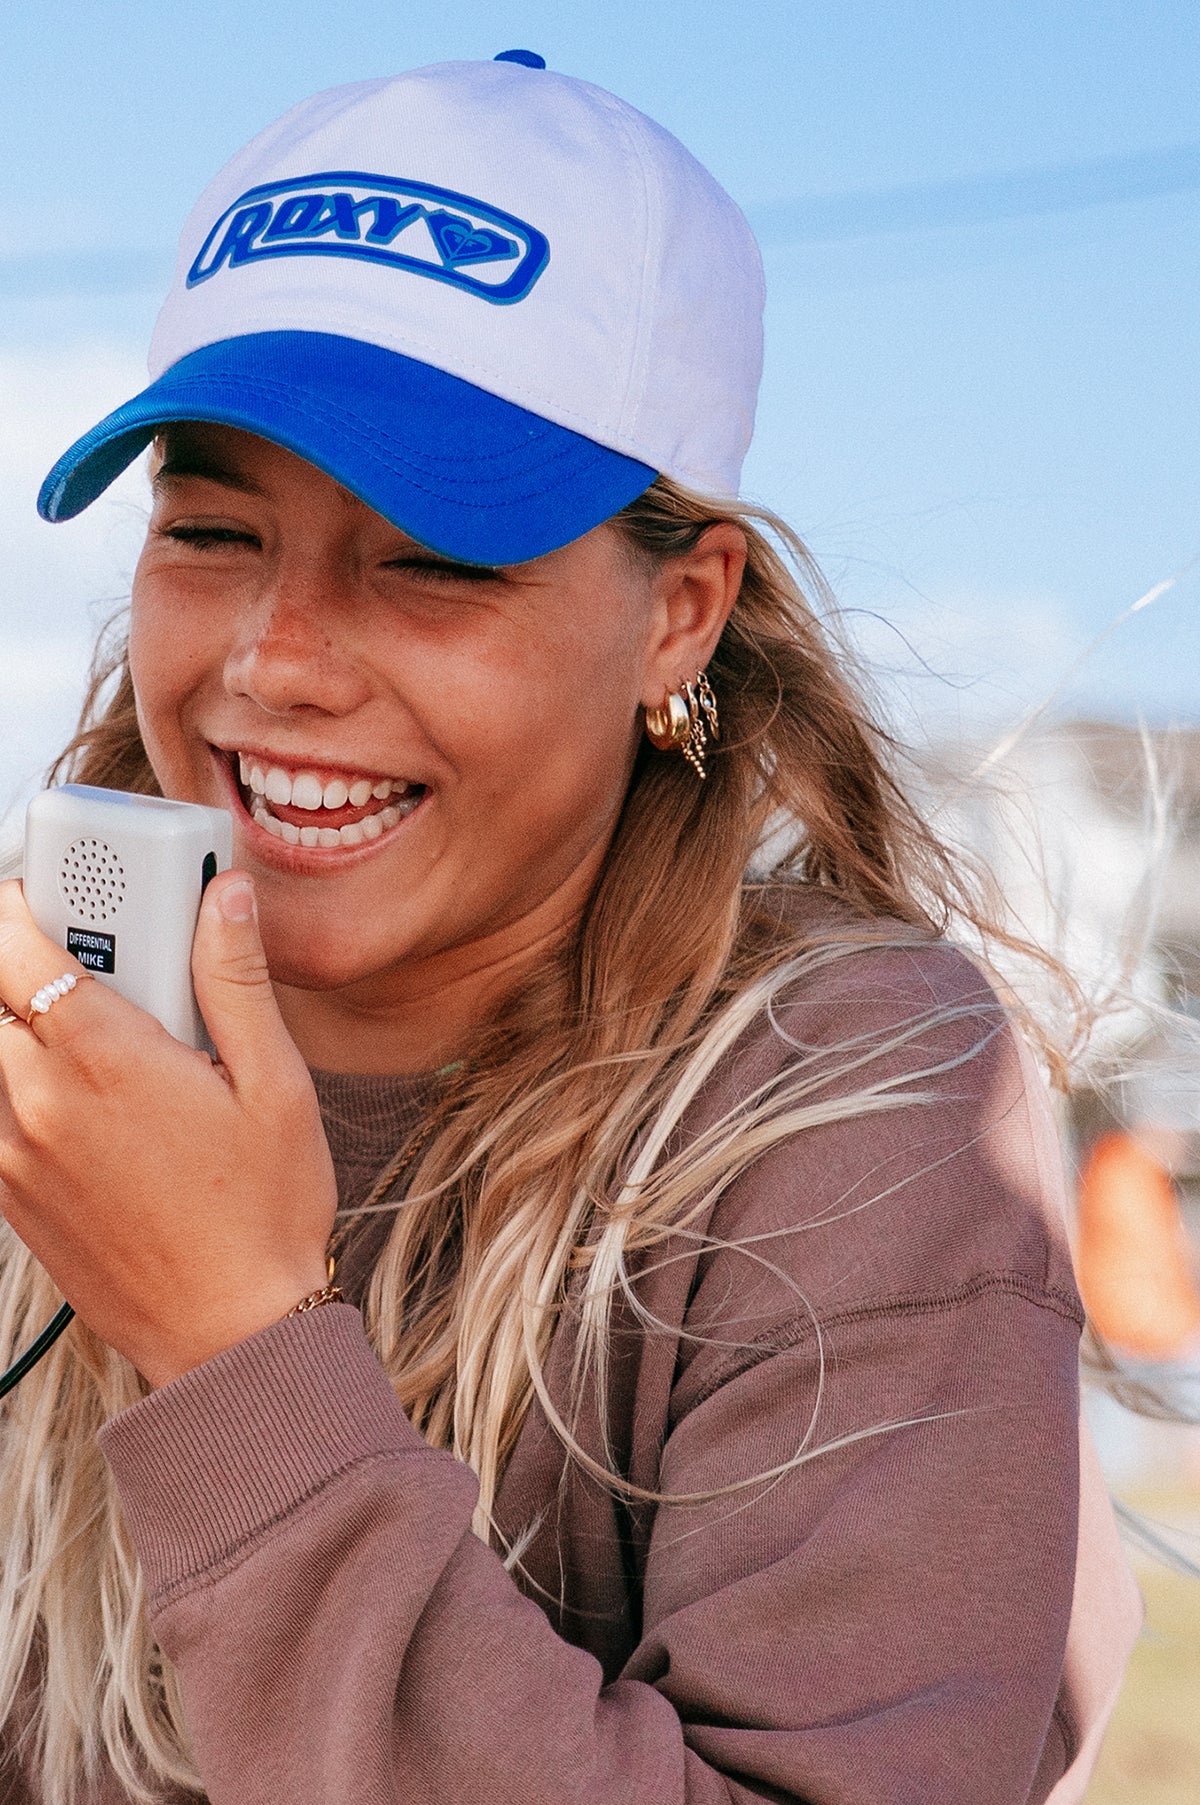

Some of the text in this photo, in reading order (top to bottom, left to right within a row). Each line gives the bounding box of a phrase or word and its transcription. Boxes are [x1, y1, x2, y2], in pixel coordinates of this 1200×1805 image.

[206, 191, 427, 273] ROXY
[69, 932, 112, 952] DIFFERENTIAL
[78, 951, 104, 968] MIKE
